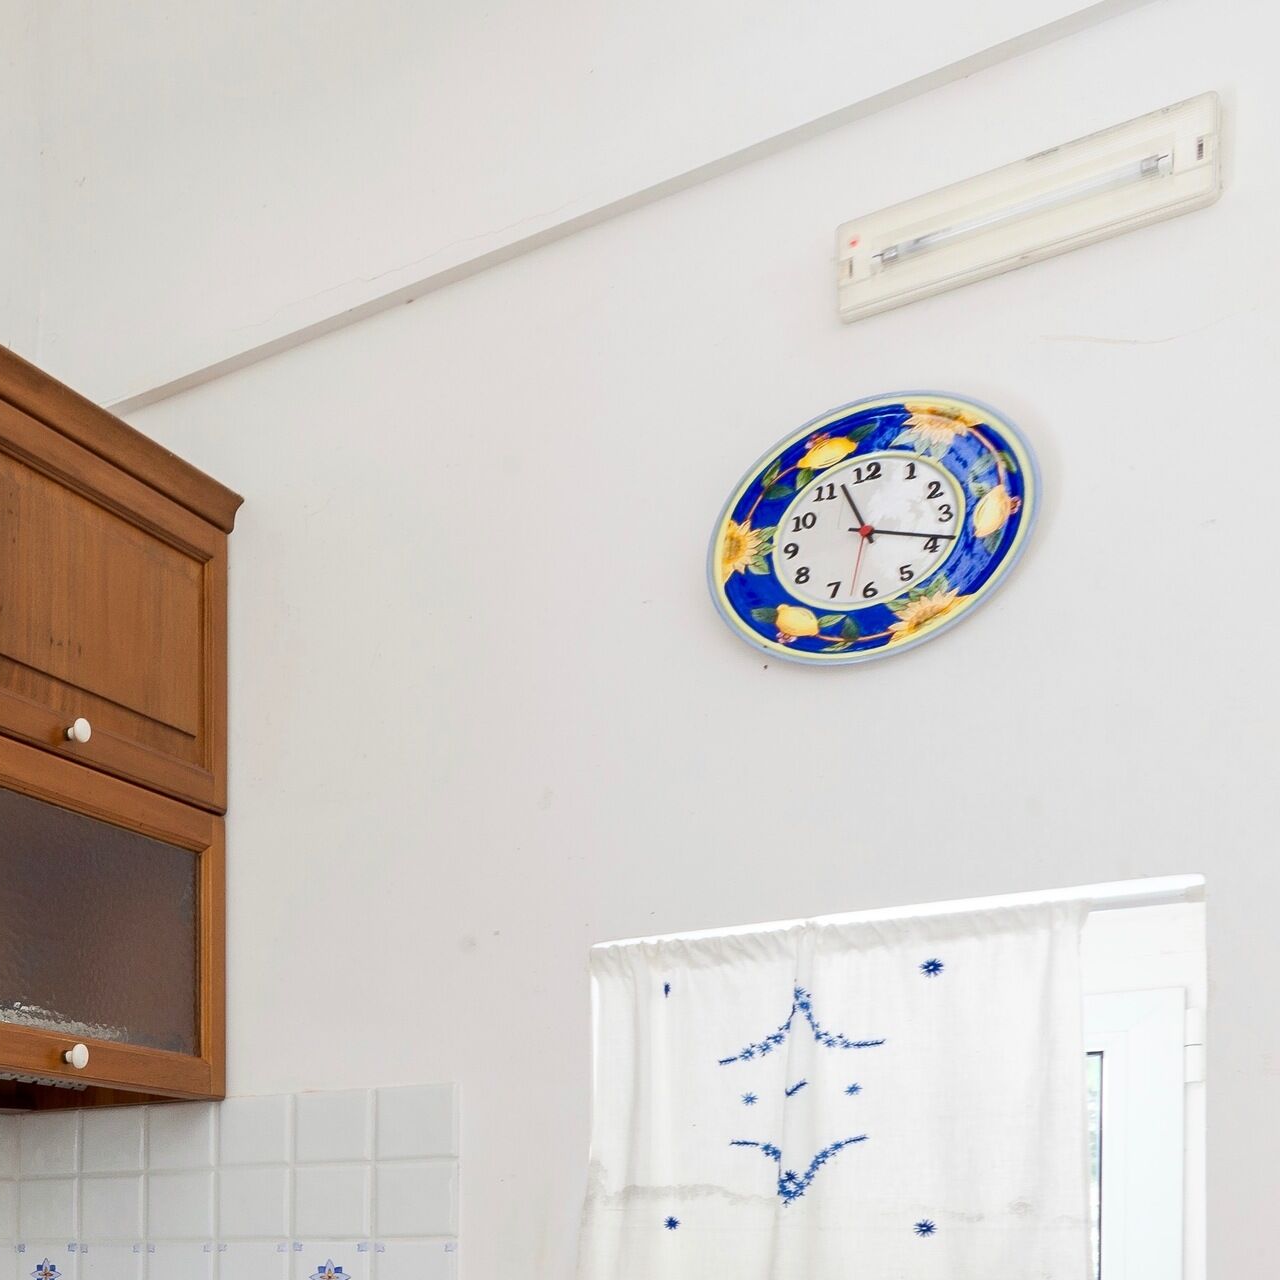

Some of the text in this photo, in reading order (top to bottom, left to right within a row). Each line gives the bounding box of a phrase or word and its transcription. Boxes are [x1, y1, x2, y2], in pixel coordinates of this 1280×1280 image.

[852, 462, 882, 485] 12
[905, 462, 917, 480] 1
[812, 482, 838, 502] 11
[926, 481, 944, 499] 2
[938, 504, 954, 522] 3
[792, 512, 817, 533] 10
[784, 542, 799, 560] 9
[923, 536, 940, 553] 4
[794, 566, 810, 584] 8
[899, 564, 914, 582] 5
[826, 581, 841, 598] 7
[862, 581, 878, 598] 6
